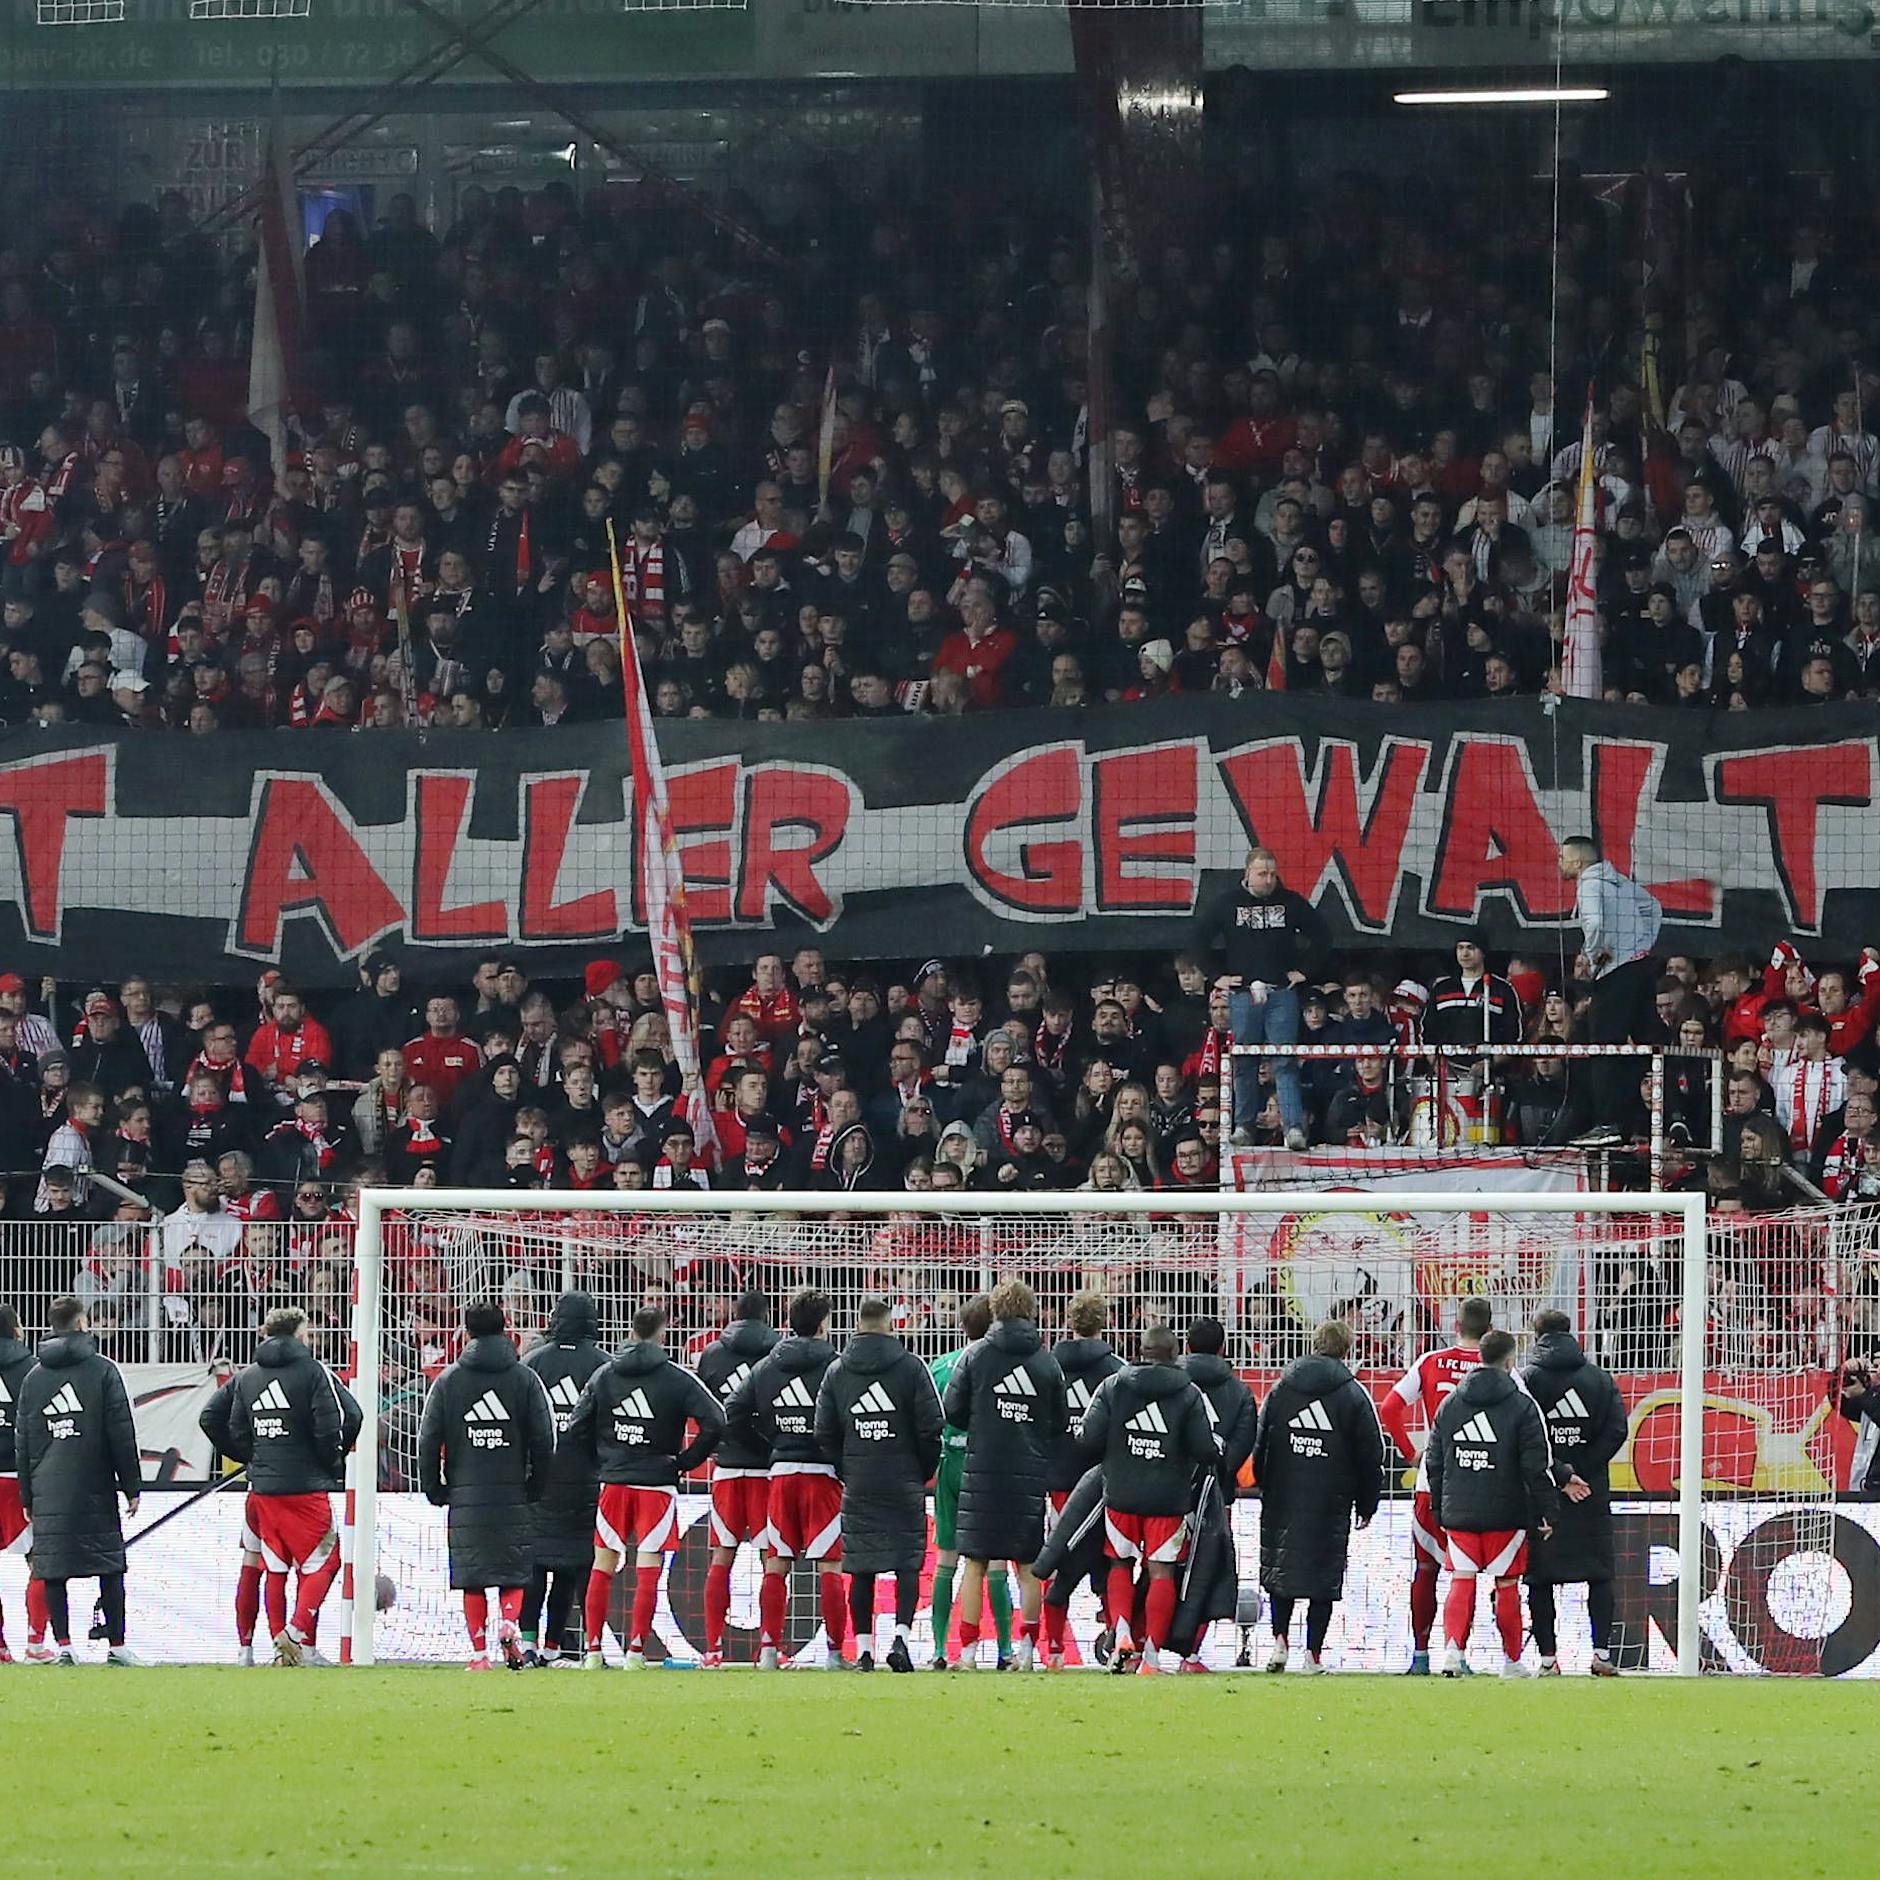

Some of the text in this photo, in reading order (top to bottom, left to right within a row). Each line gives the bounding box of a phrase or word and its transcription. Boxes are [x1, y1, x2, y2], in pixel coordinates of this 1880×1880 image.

[226, 755, 864, 964] ALLER
[964, 733, 1878, 935] GEWALT
[1446, 1358, 1459, 1369] FC
[997, 1398, 1029, 1412] home
[775, 1414, 806, 1426] home
[1001, 1410, 1013, 1419] to
[47, 1418, 75, 1432] home
[254, 1417, 282, 1430] home
[614, 1421, 644, 1435] home
[781, 1424, 790, 1433] to
[855, 1418, 888, 1431] home
[257, 1427, 267, 1437] to
[468, 1426, 502, 1438] home
[859, 1428, 872, 1438] to
[1551, 1425, 1581, 1437] home
[473, 1435, 485, 1446] to
[617, 1433, 628, 1442] to
[1128, 1434, 1161, 1449] home
[1290, 1433, 1323, 1447] home
[1554, 1434, 1567, 1444] to
[1131, 1445, 1144, 1456] to
[1293, 1444, 1305, 1454] to
[1455, 1446, 1488, 1460] home
[1459, 1458, 1471, 1468] to
